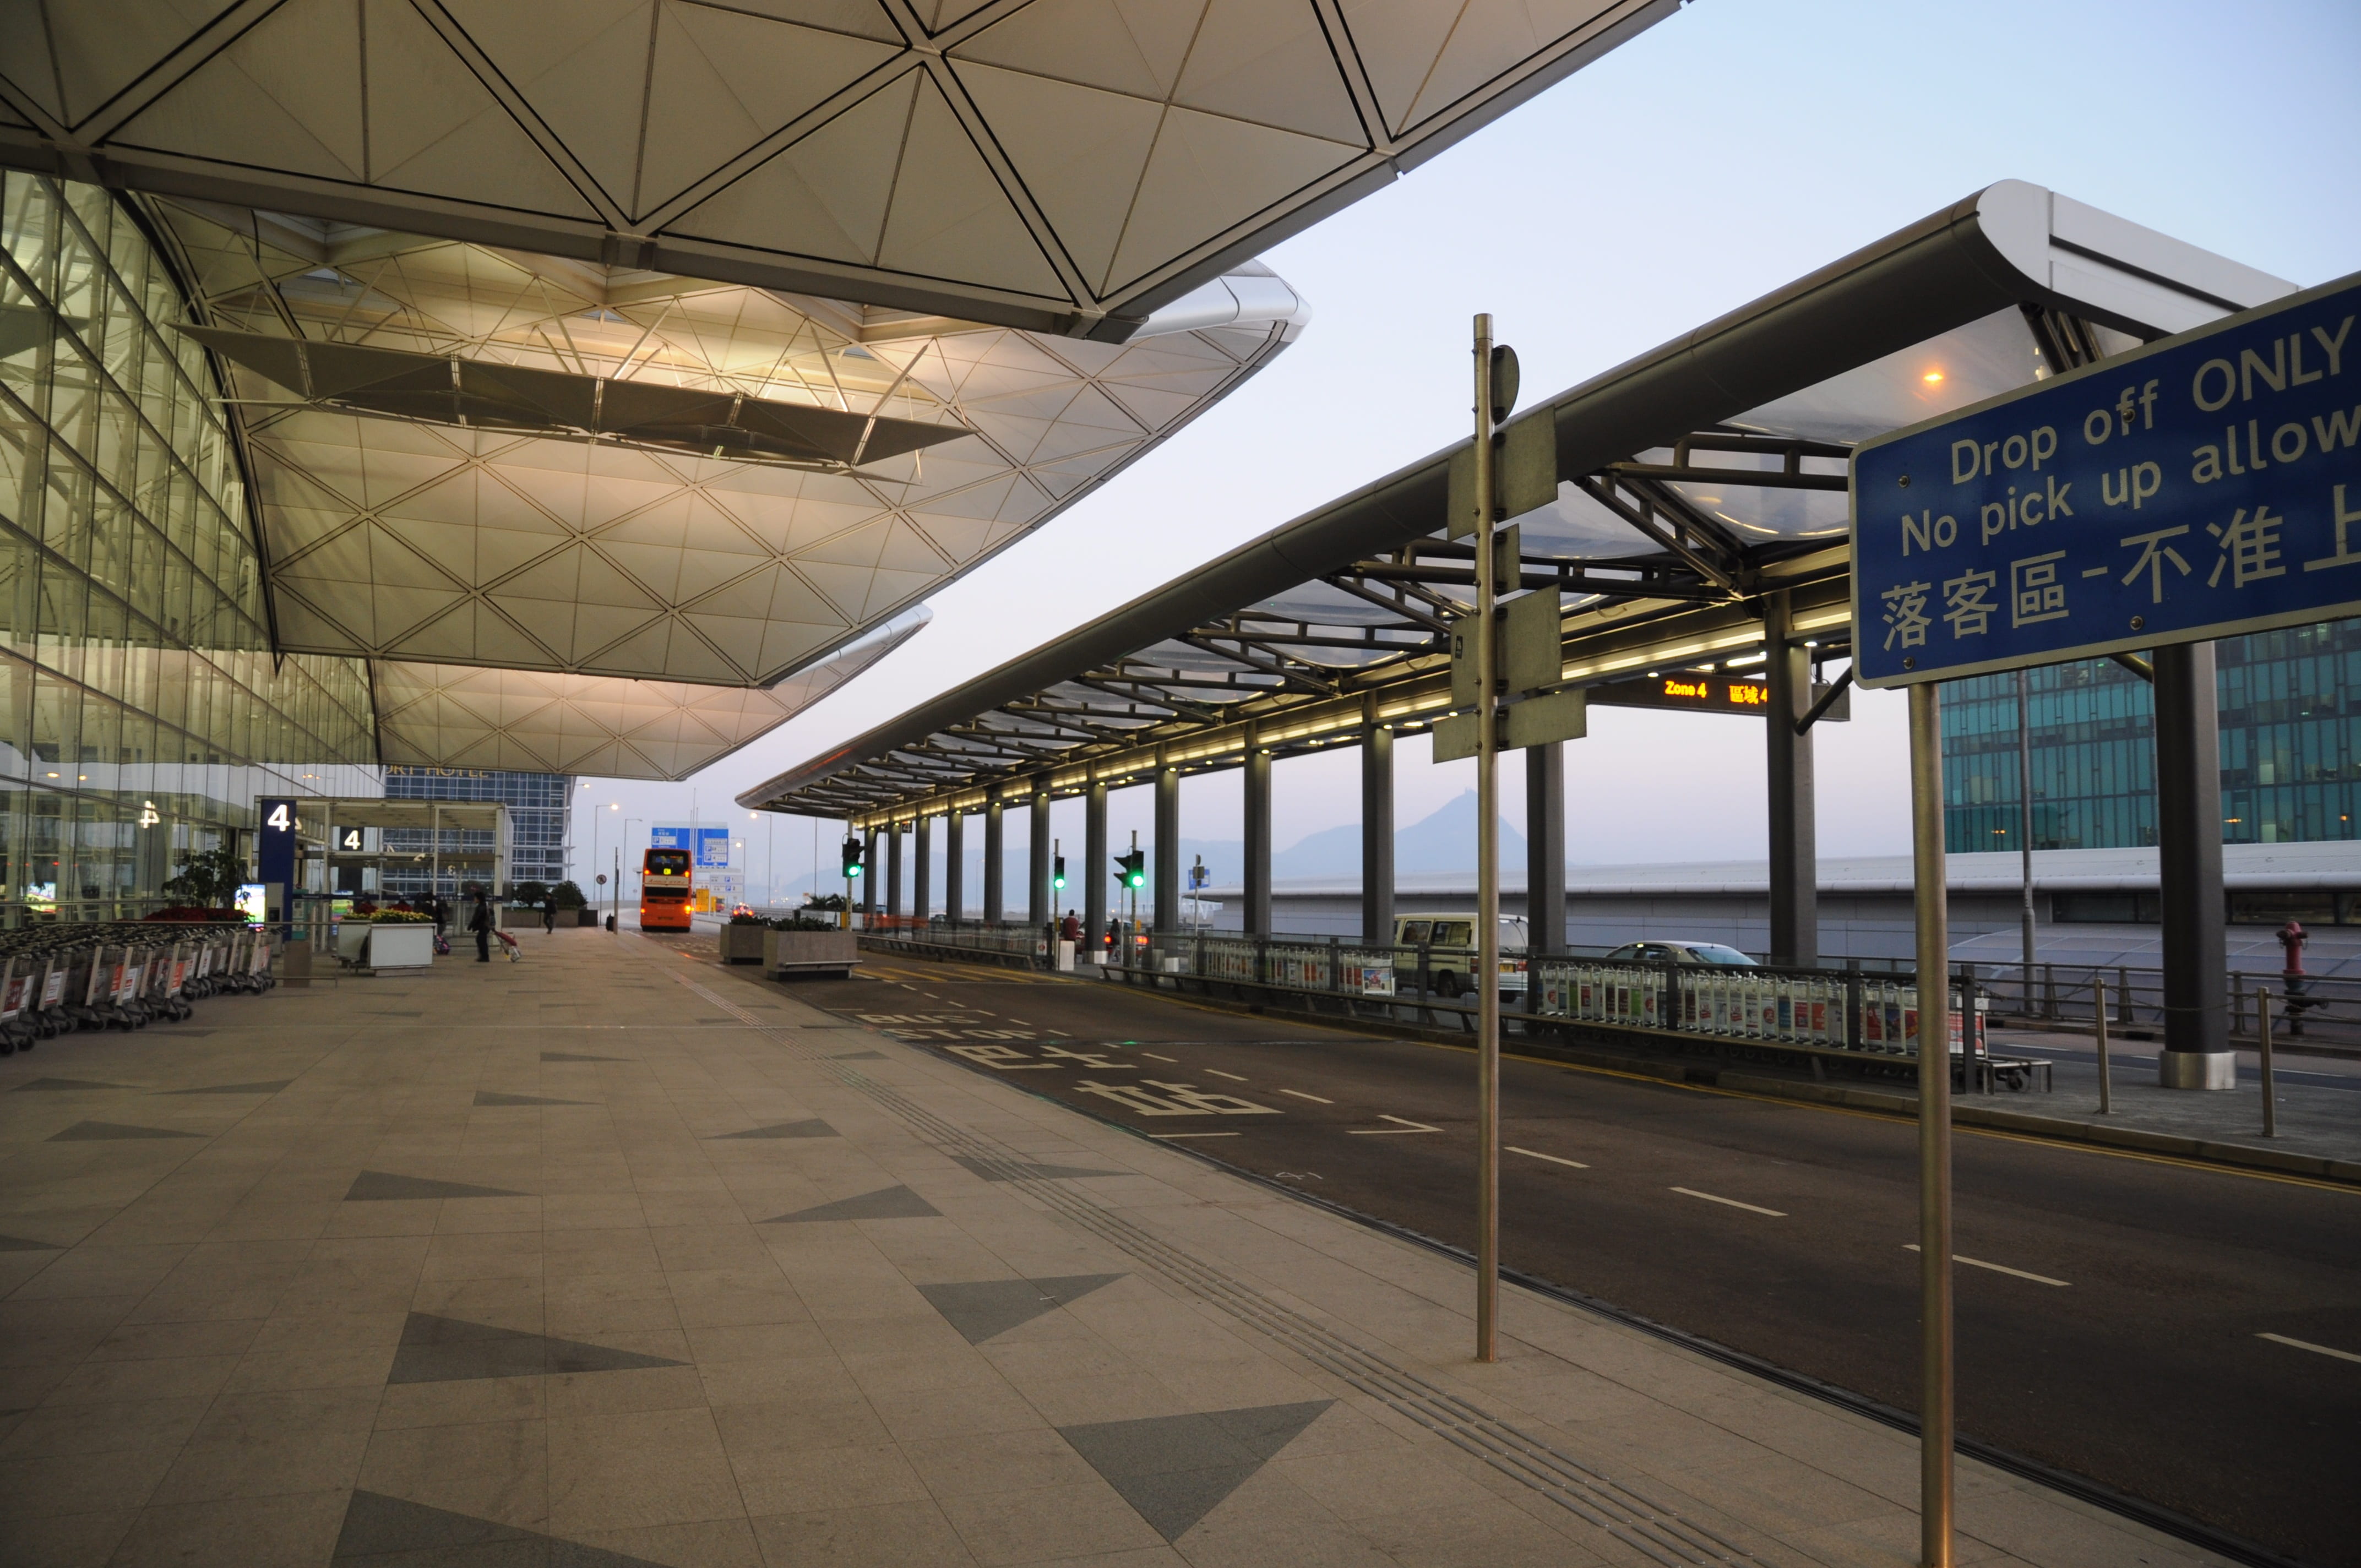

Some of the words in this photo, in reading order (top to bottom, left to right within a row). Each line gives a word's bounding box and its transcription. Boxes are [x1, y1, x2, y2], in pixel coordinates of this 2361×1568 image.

[1951, 425, 2057, 485] Drop
[2084, 379, 2159, 444] off
[2193, 315, 2356, 412] ONLY
[1902, 509, 1957, 557] No
[1982, 475, 2074, 546] pick
[2102, 461, 2162, 509] up
[1665, 680, 1695, 696] Zone
[1697, 682, 1707, 698] 4
[268, 804, 290, 831] 4
[903, 823, 911, 832] 4
[344, 830, 361, 850] 4
[855, 1015, 981, 1023] BUS
[882, 1028, 1037, 1039] STOP
[943, 1045, 1139, 1070] 巴士
[1072, 1080, 1287, 1117] 站
